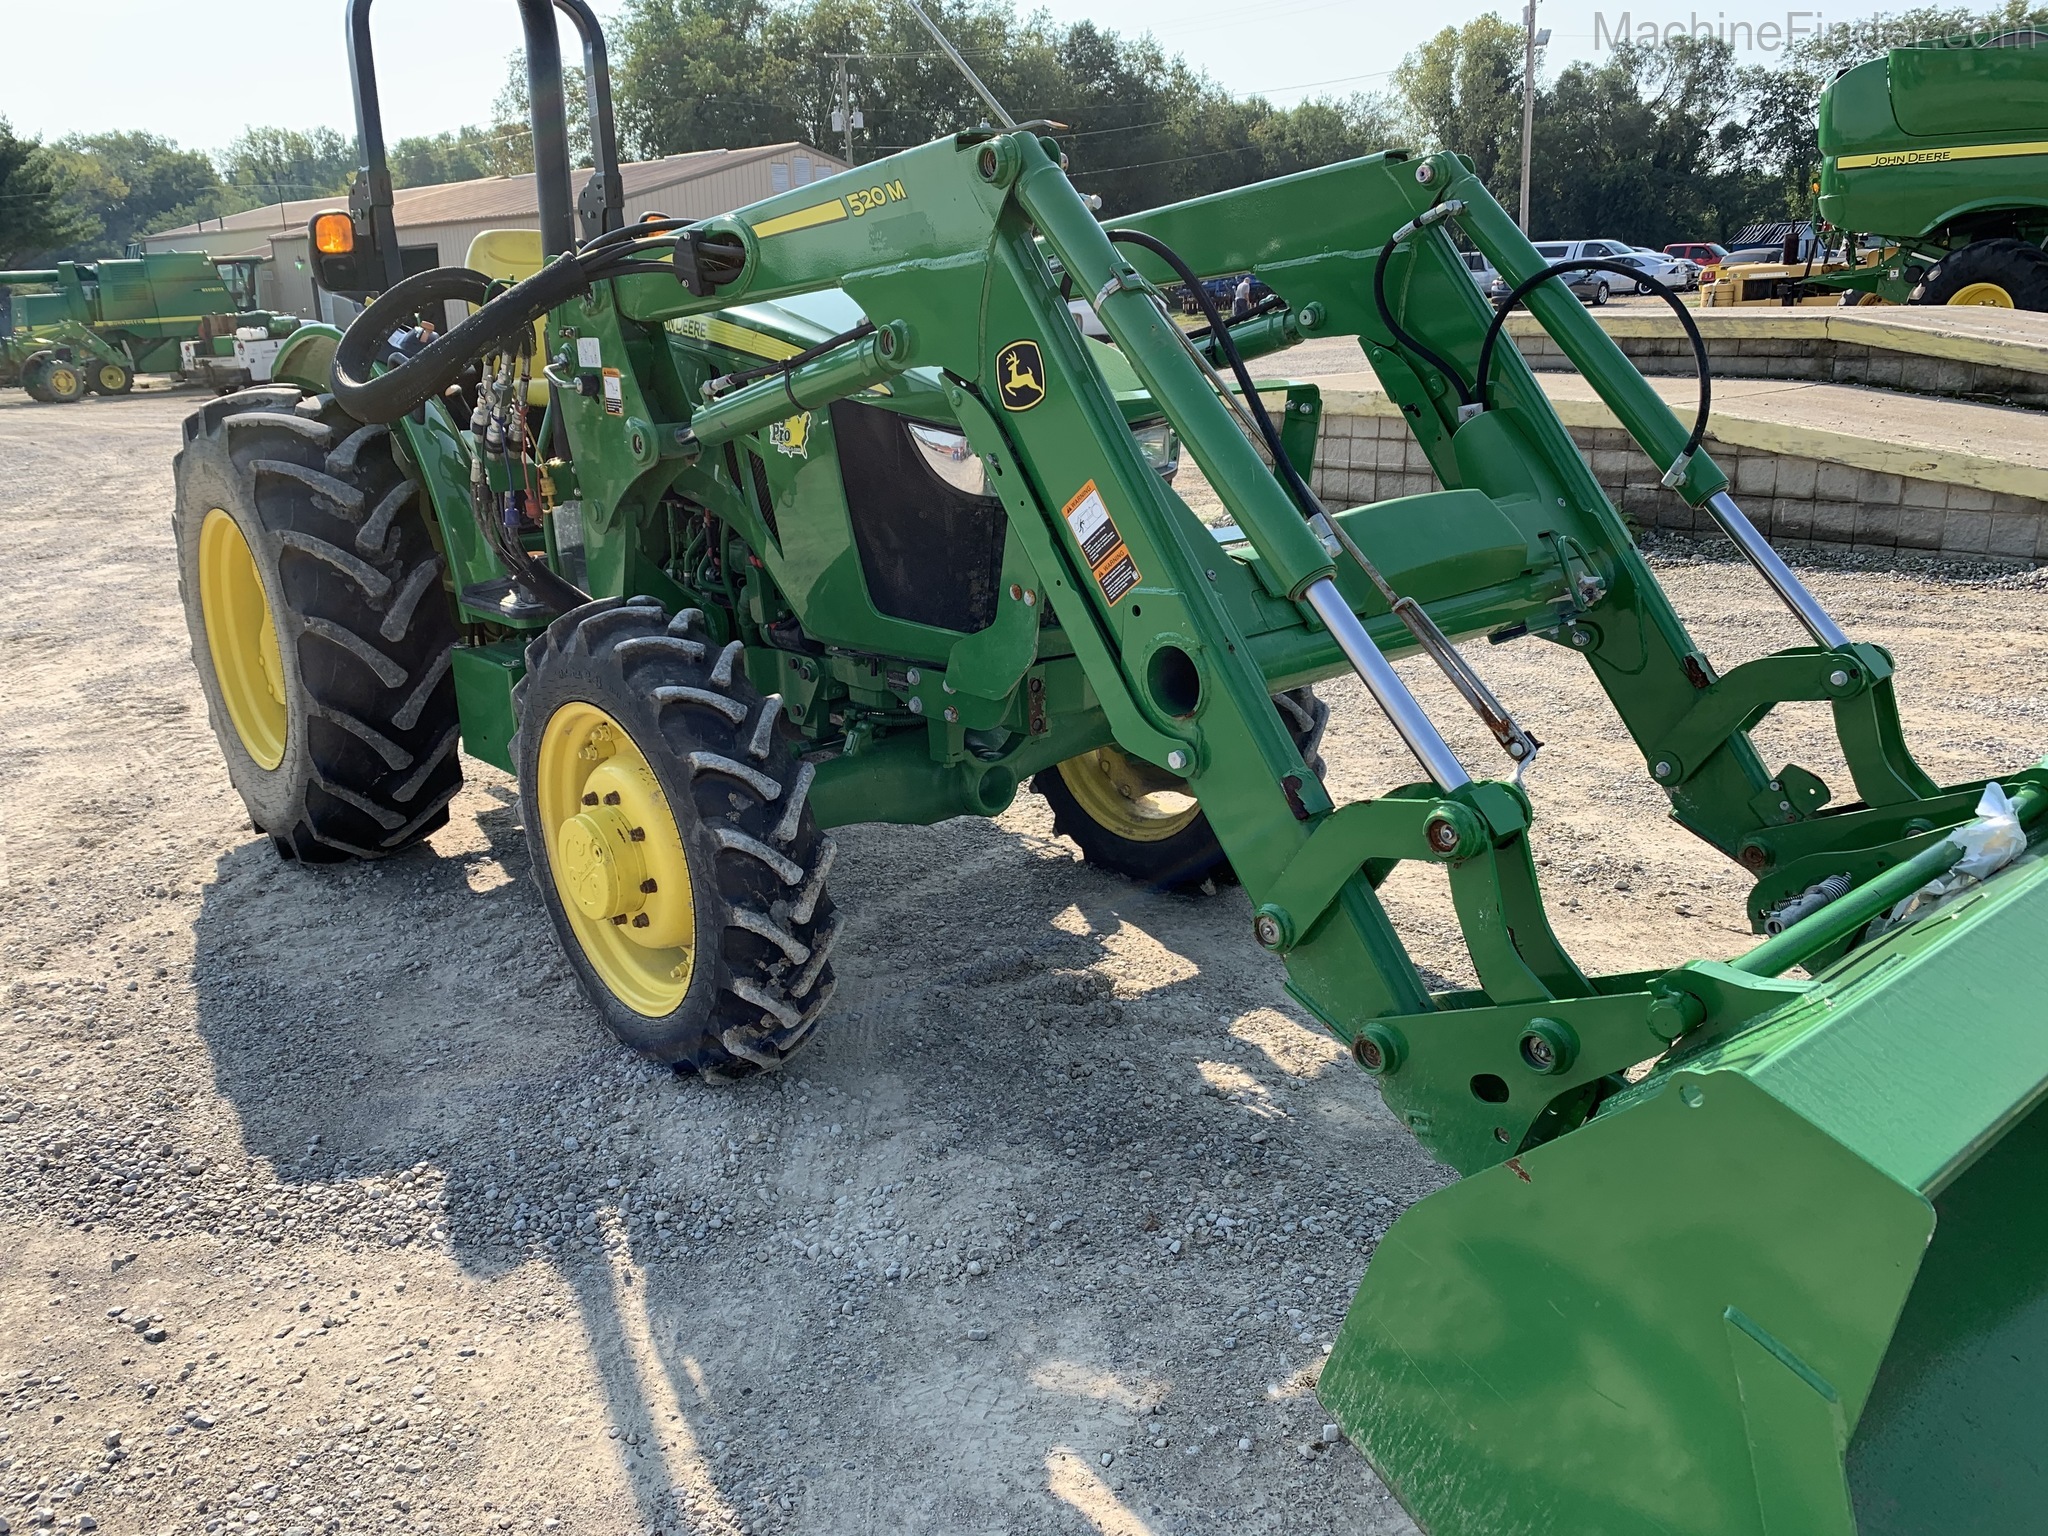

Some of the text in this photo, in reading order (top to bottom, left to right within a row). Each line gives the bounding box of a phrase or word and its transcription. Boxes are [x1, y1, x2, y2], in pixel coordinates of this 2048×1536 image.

[1871, 151, 1951, 167] JOHN DEERE
[845, 178, 908, 217] 520 M
[771, 424, 791, 441] Pro
[1071, 485, 1092, 508] WARNING
[1103, 550, 1125, 571] WARNING
